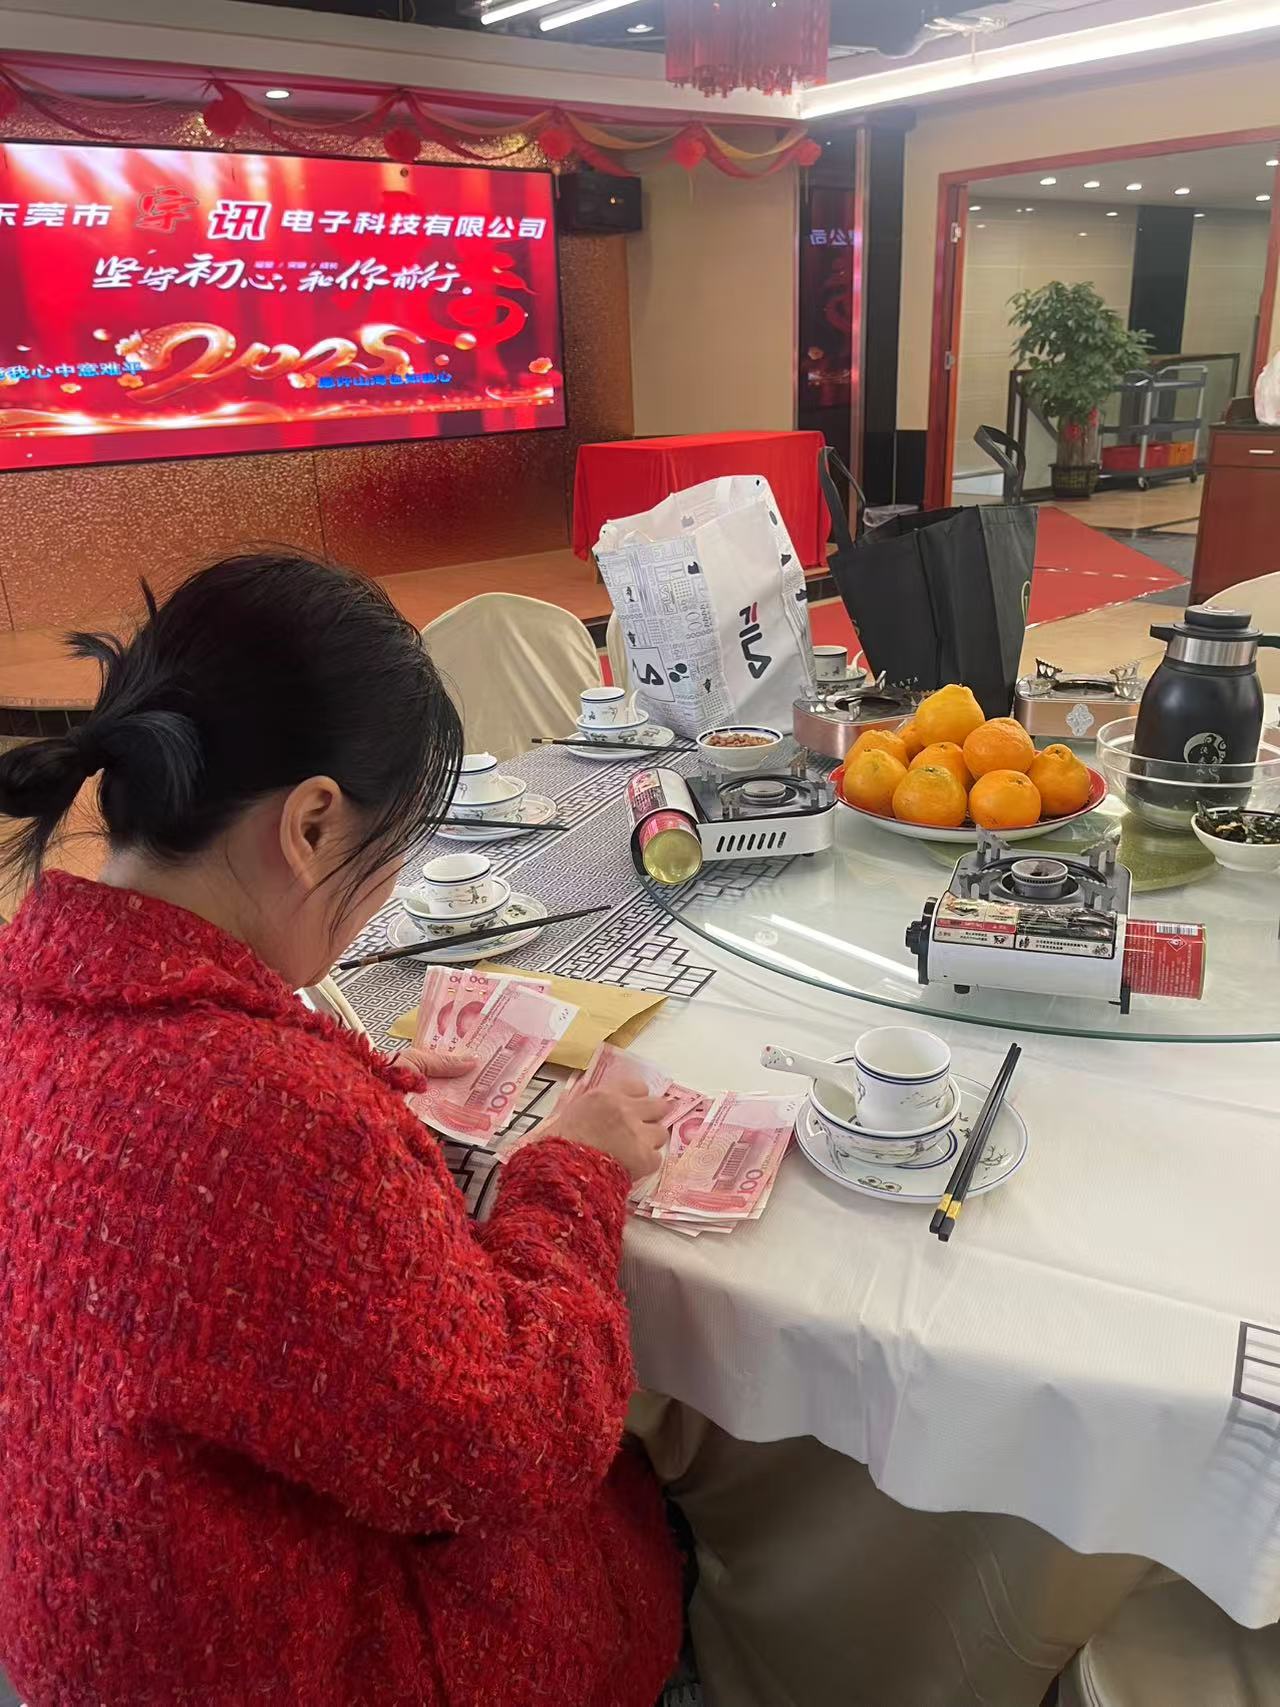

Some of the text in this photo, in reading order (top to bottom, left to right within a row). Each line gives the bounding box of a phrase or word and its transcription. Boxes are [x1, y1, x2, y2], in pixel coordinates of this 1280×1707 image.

[738, 601, 772, 680] FILA
[486, 1081, 517, 1115] 100
[736, 1169, 764, 1195] 100
